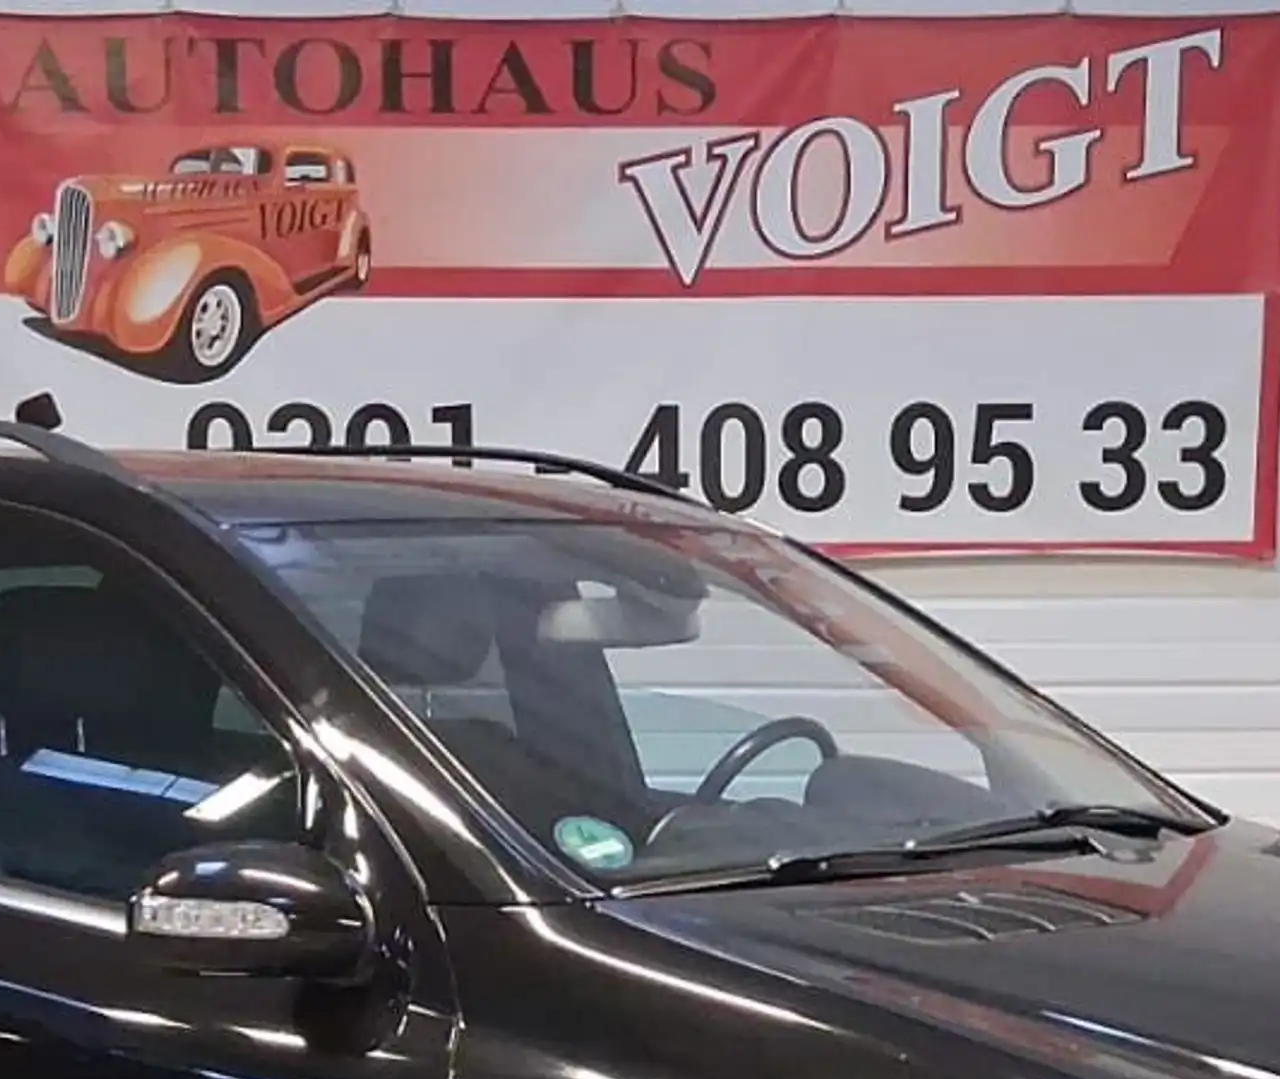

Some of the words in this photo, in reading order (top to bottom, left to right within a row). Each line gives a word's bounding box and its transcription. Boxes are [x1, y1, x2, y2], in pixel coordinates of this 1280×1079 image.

[6, 36, 718, 118] AUTOHAUS
[622, 26, 1223, 289] VOIGT
[258, 197, 346, 241] VOIGT
[622, 401, 847, 515] 408
[890, 402, 1035, 513] 95
[1079, 400, 1228, 513] 33
